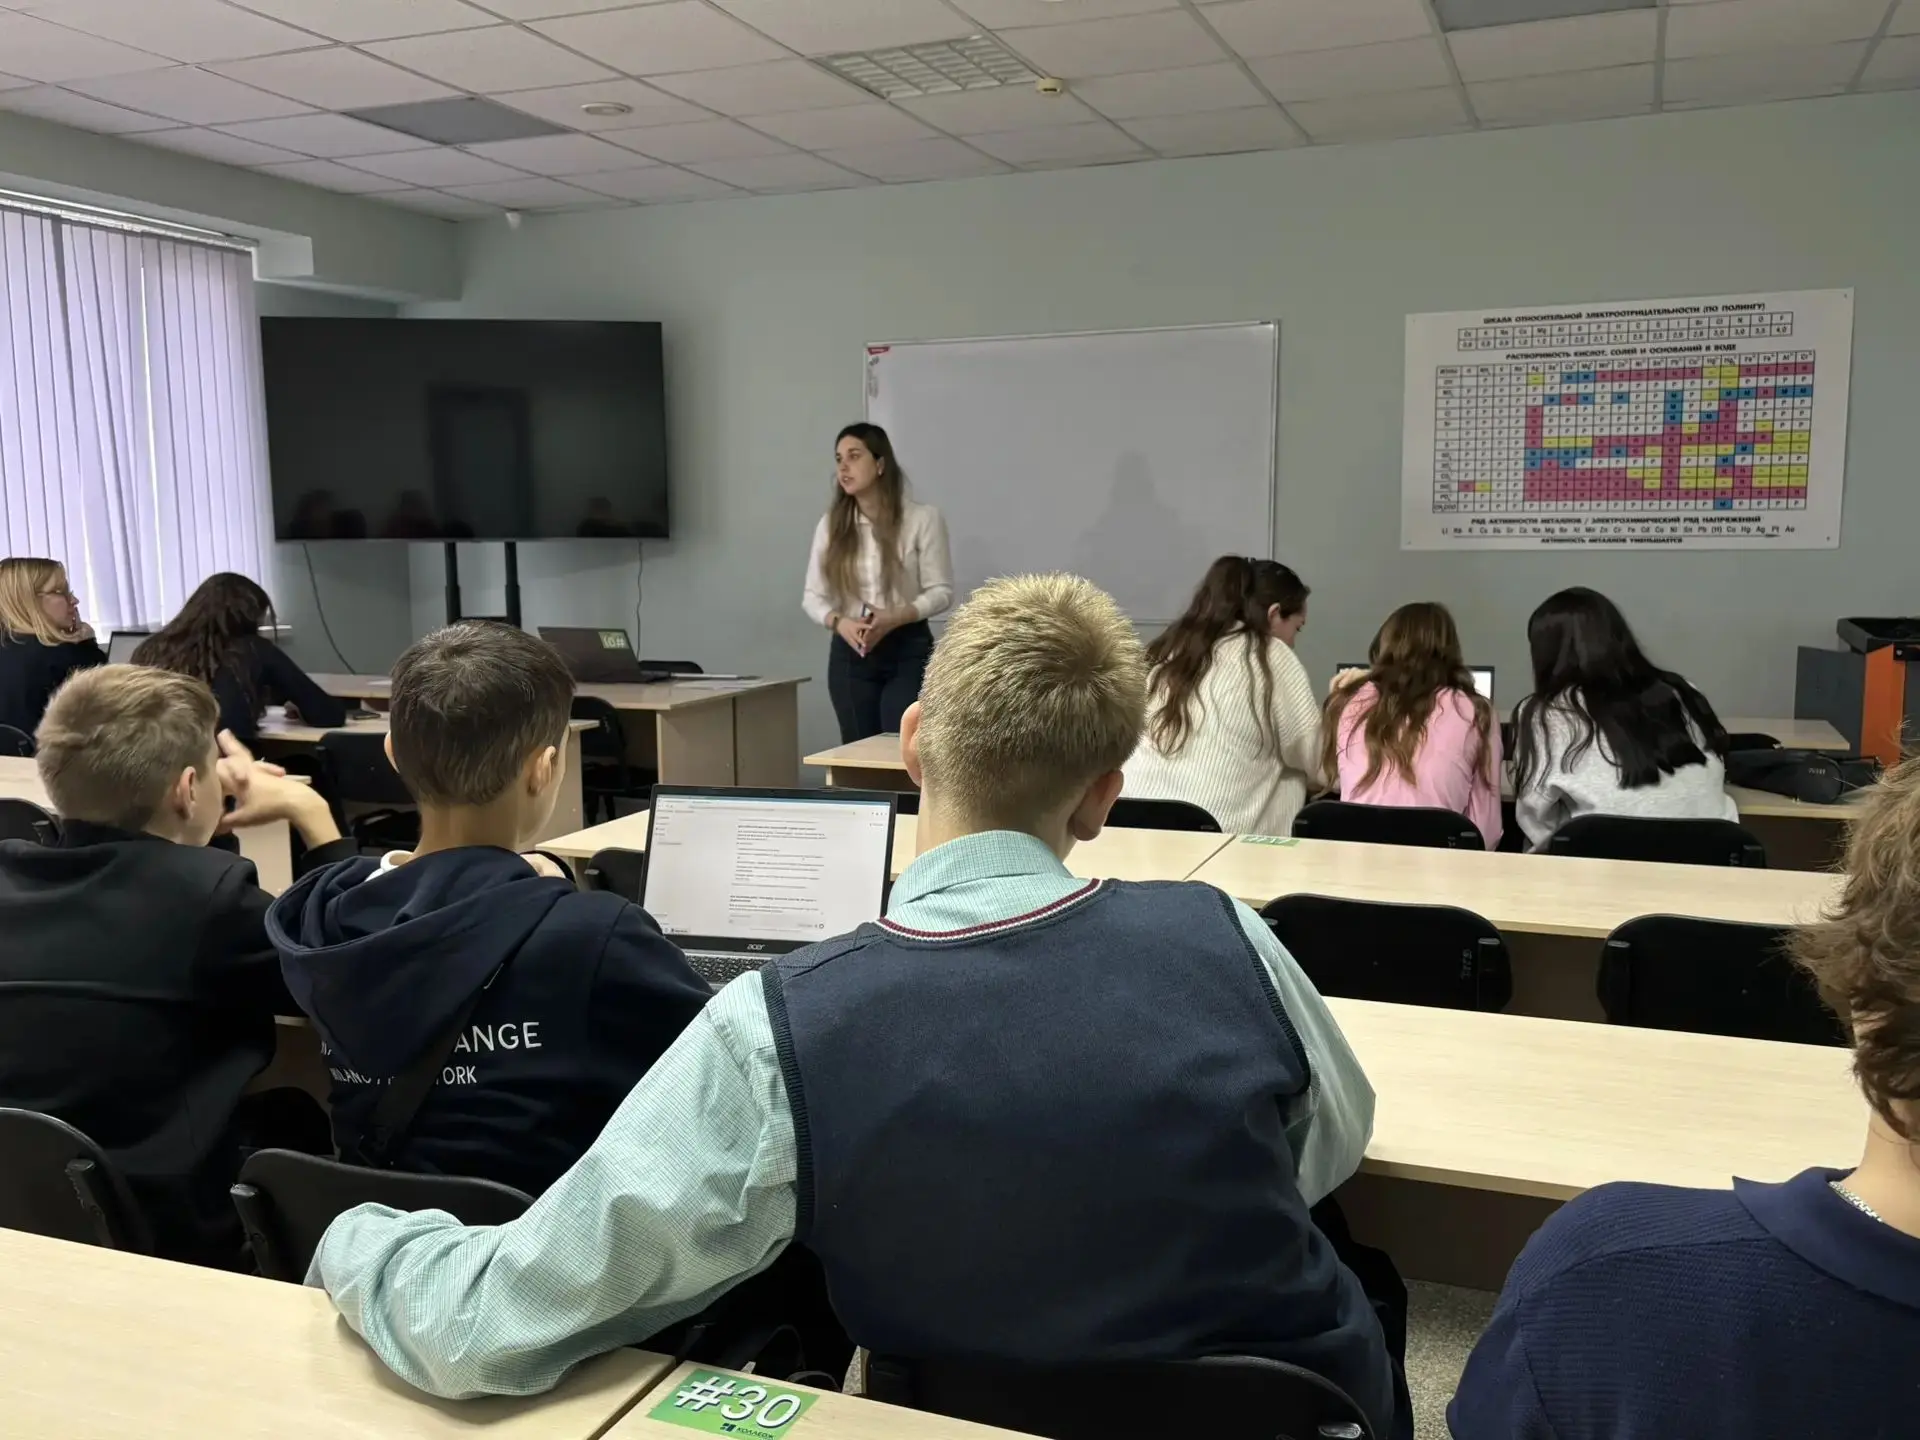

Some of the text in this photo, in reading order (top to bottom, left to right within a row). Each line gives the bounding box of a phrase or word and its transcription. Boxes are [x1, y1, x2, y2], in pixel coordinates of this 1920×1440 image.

[454, 1021, 542, 1052] ANGE
[436, 1066, 477, 1084] ORK
[674, 1376, 801, 1428] #30
